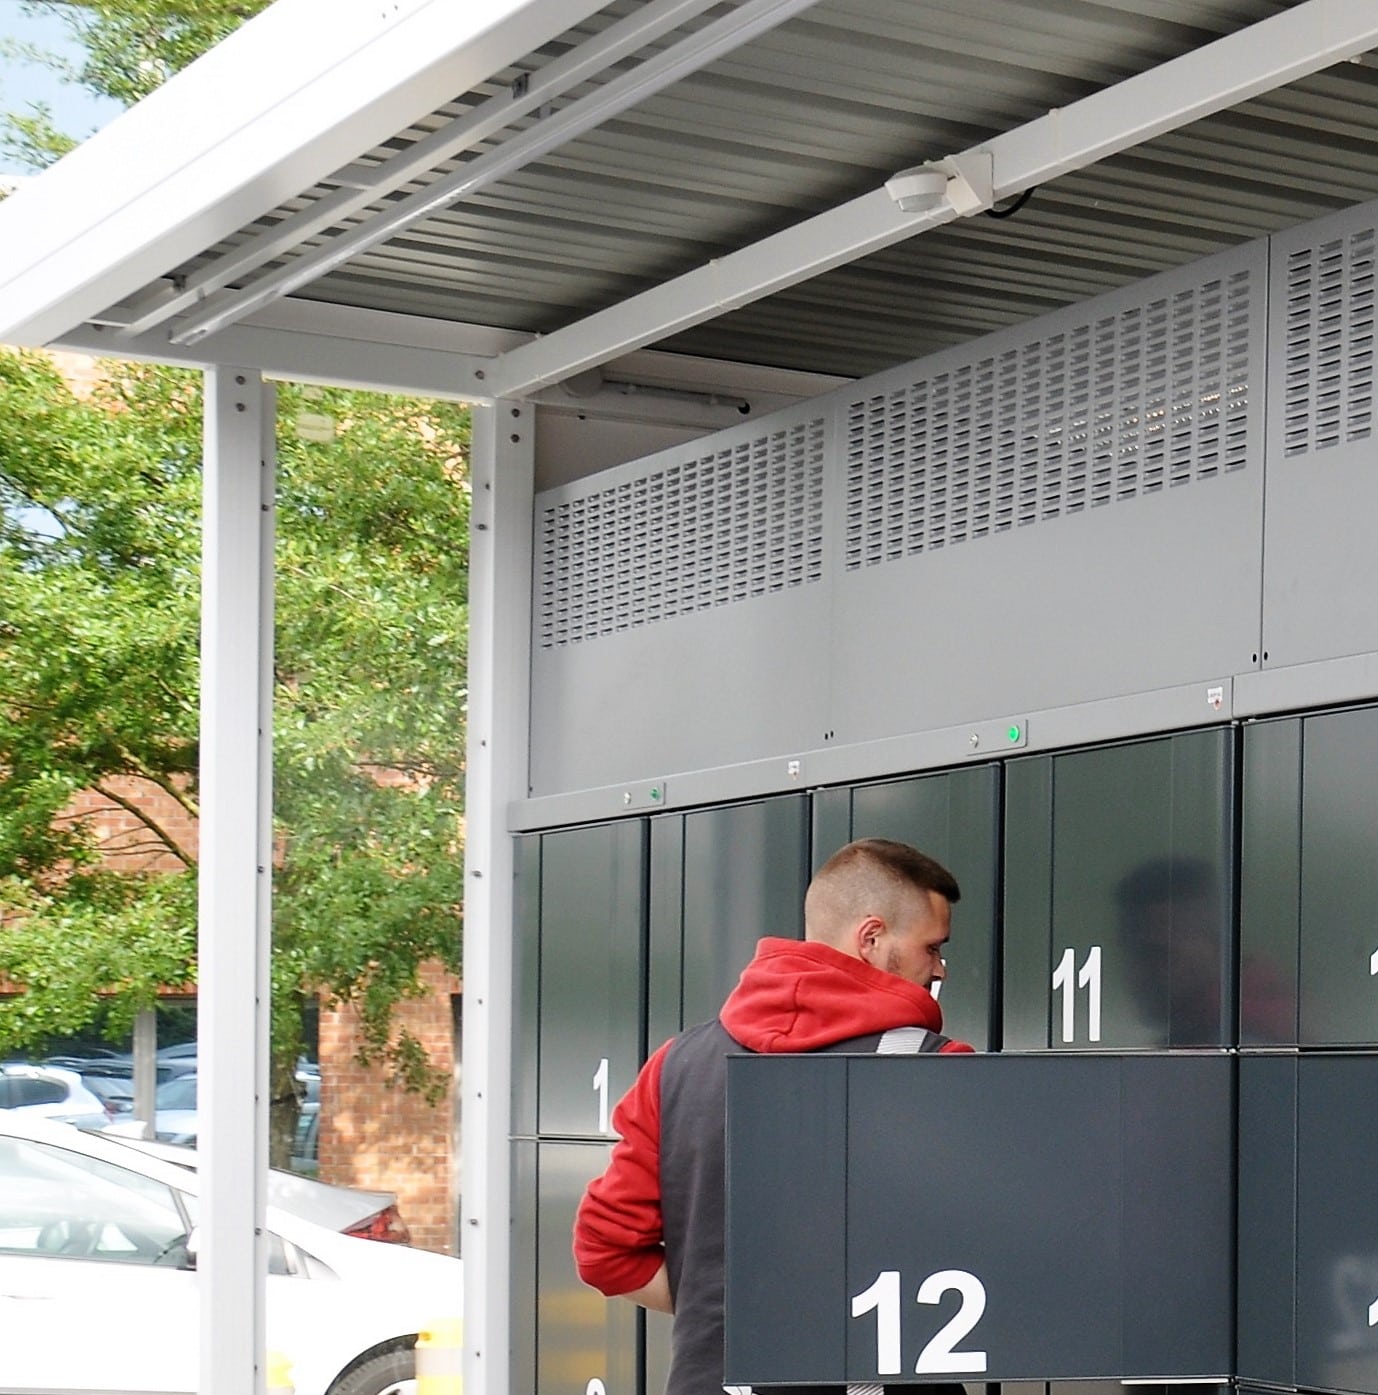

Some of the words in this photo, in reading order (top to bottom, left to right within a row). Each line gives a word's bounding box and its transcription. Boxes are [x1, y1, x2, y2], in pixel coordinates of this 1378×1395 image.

[1052, 946, 1101, 1043] 11
[593, 1058, 609, 1134] 1
[851, 1269, 987, 1375] 12
